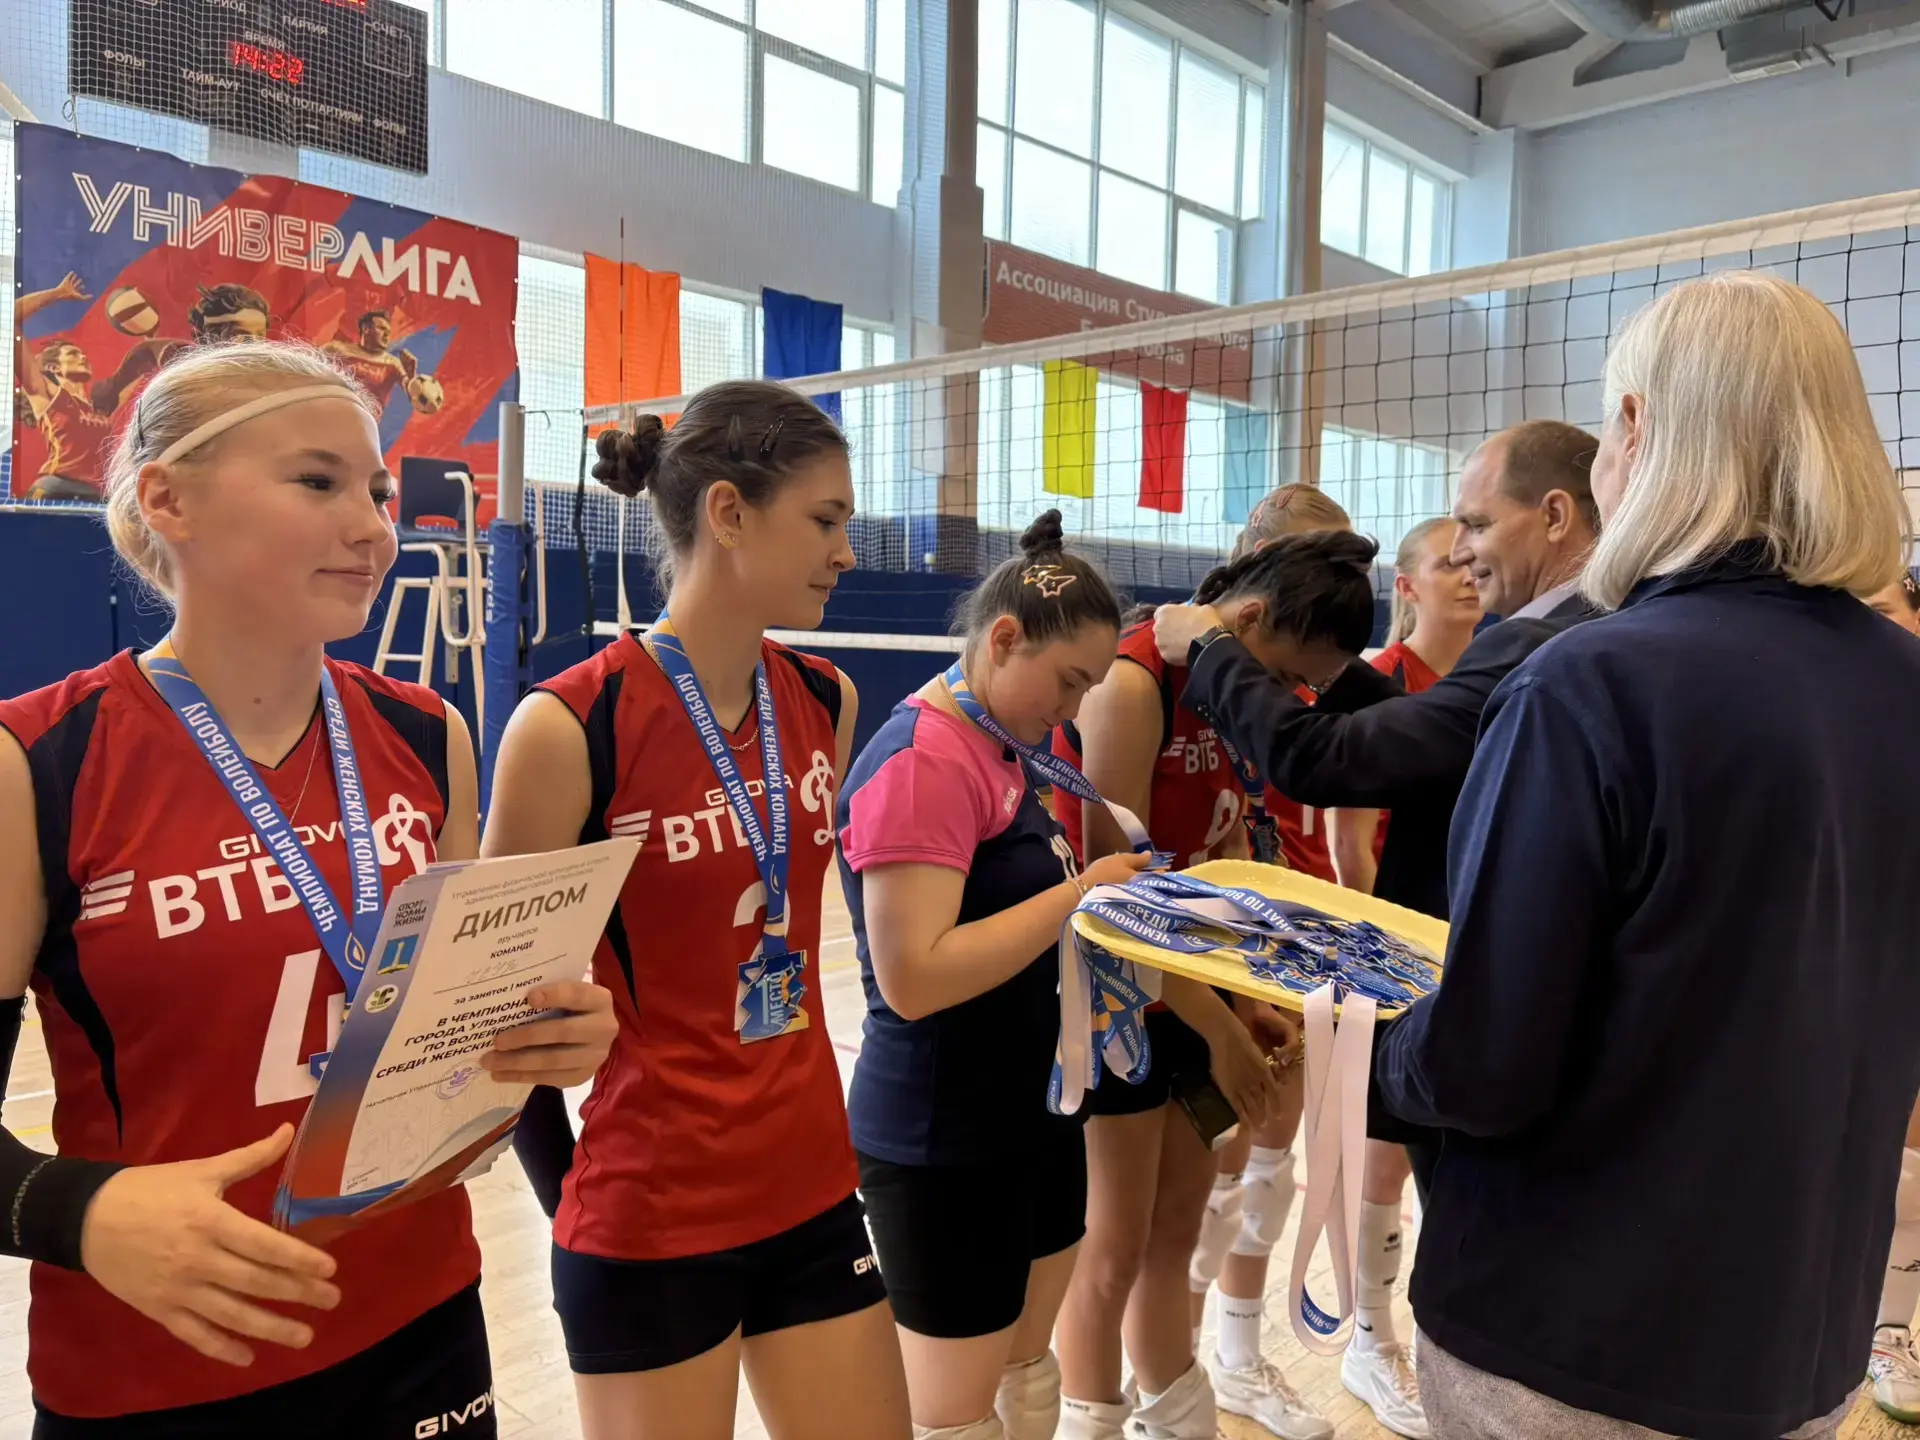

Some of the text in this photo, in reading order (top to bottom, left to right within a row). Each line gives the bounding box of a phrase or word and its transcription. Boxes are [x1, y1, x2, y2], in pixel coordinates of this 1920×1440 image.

[245, 30, 285, 50] ВРЕМЯ
[282, 15, 329, 37] ПАРТИЯ
[372, 20, 405, 39] СЧЕТ
[103, 49, 146, 68] ФОЛЫ
[231, 42, 304, 85] 14:22
[180, 67, 240, 91] ТАЙМ-АУТ
[261, 88, 292, 105] СЧЕТ
[72, 171, 482, 306] УНИВЕРЛИГА
[996, 261, 1119, 317] Ассоциация
[674, 671, 767, 862] ЧЕМПИОНАТ ПО ВОЛЕЙБОЛУ
[757, 676, 787, 856] СРЕДИ ЖЕНСКИХ КОМАНД
[1033, 751, 1052, 767] ПО
[1185, 740, 1219, 774] ВТБ
[180, 700, 339, 934] ЧЕМПИОНАТ ПО ВОЛЕЙБОЛУ
[326, 696, 380, 915] СРЕДИ ЖЕНСКИХ КОМАНД
[219, 821, 346, 860] GIOV
[398, 899, 424, 912] СПОРТ
[452, 882, 588, 943] ДИПЛОМ
[1126, 903, 1170, 930] СРЕДИ
[1243, 897, 1265, 912] ПО
[1090, 902, 1172, 946] ЧЕМПИОНАТ
[490, 939, 535, 959] КОМАНДЕ
[468, 985, 508, 1001] занятое
[515, 975, 543, 989] место
[768, 969, 787, 1027] МЕСТО
[1094, 964, 1140, 1004] УЛЬЯНОВСКА
[437, 997, 529, 1028] В ЧЕМПИОНА
[404, 1025, 465, 1047] ГОРОДА
[423, 1042, 445, 1053] ПО
[376, 1057, 427, 1079] СРЕДИ
[415, 1384, 495, 1440] GIVOV
